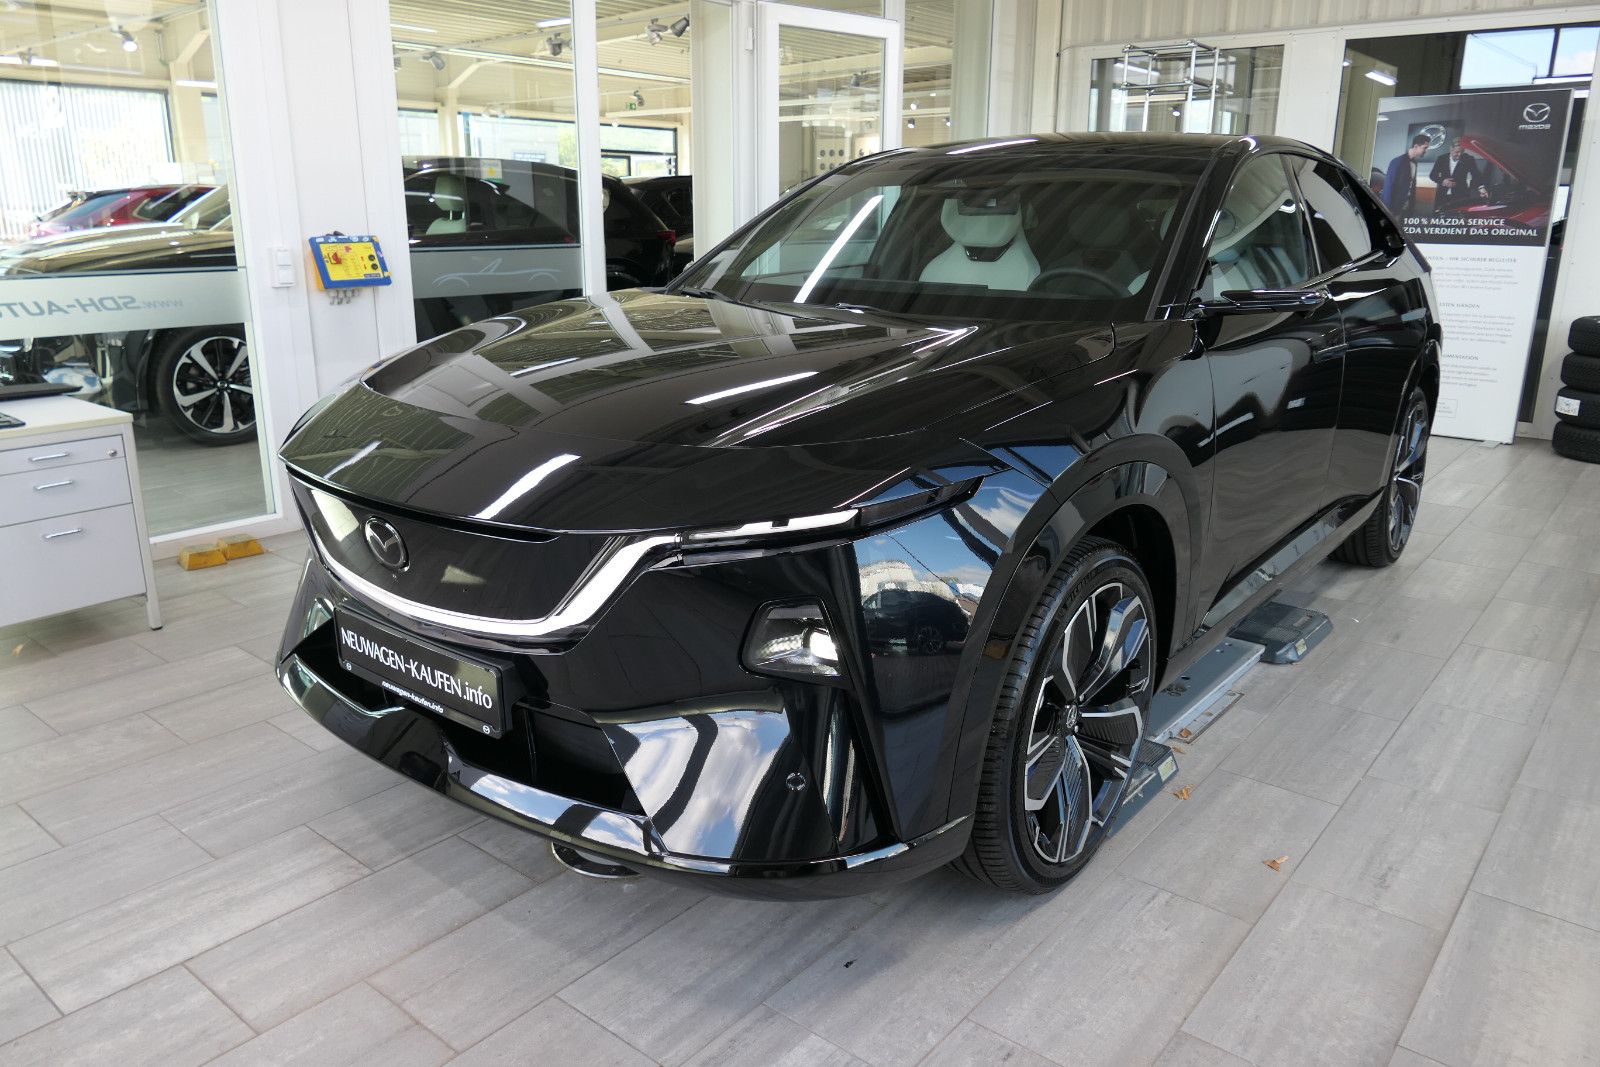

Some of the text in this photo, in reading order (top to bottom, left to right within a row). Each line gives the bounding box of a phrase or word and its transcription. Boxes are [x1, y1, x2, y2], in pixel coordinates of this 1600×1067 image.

[1403, 217, 1505, 226] 100 % MAZDA SERVICE
[1403, 226, 1422, 234] ZDA
[1424, 227, 1468, 235] VERDIENT
[1491, 228, 1538, 236] ORIGINAL
[341, 626, 493, 709] NEUWAGEN-KAUFEN.info
[381, 680, 444, 714] neuwagen-kaufen.info
